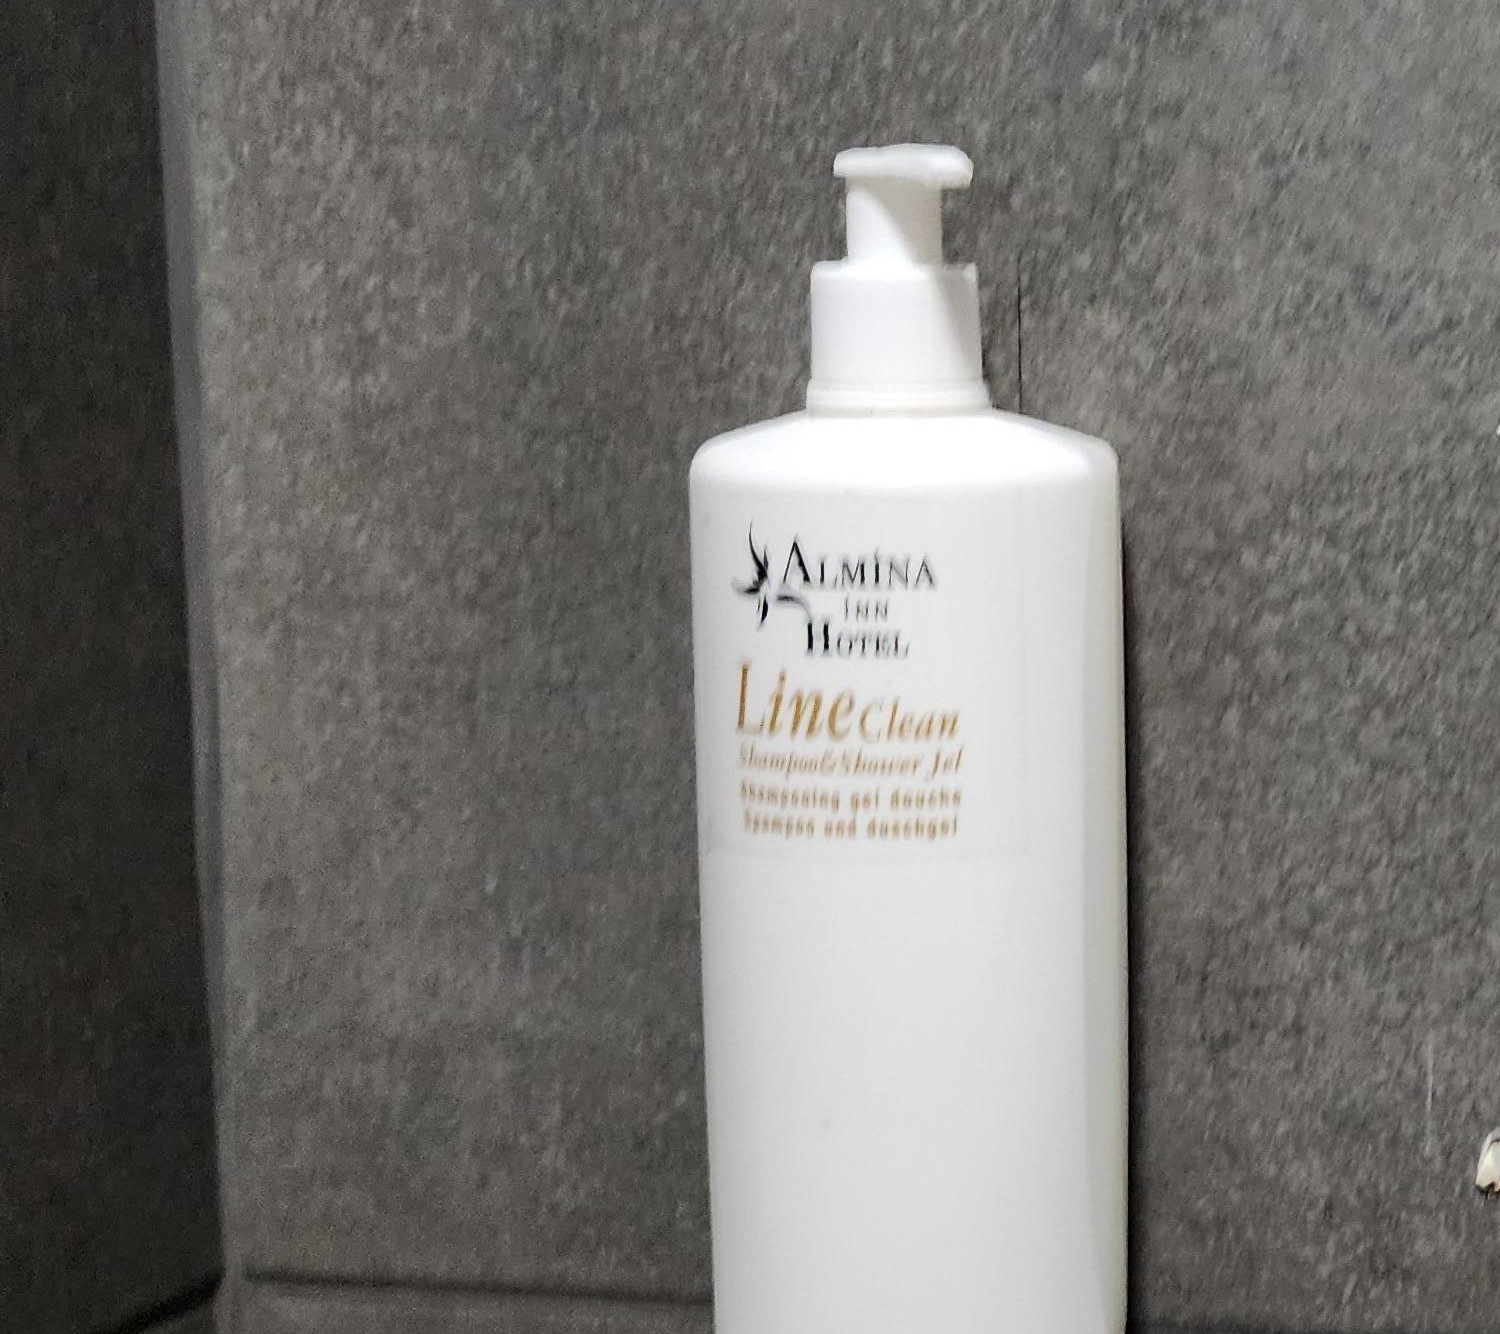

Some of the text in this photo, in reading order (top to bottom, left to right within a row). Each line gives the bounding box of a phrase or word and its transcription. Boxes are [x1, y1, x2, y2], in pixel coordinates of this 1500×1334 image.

[803, 616, 911, 658] HOTEL
[734, 661, 959, 743] Line Clean
